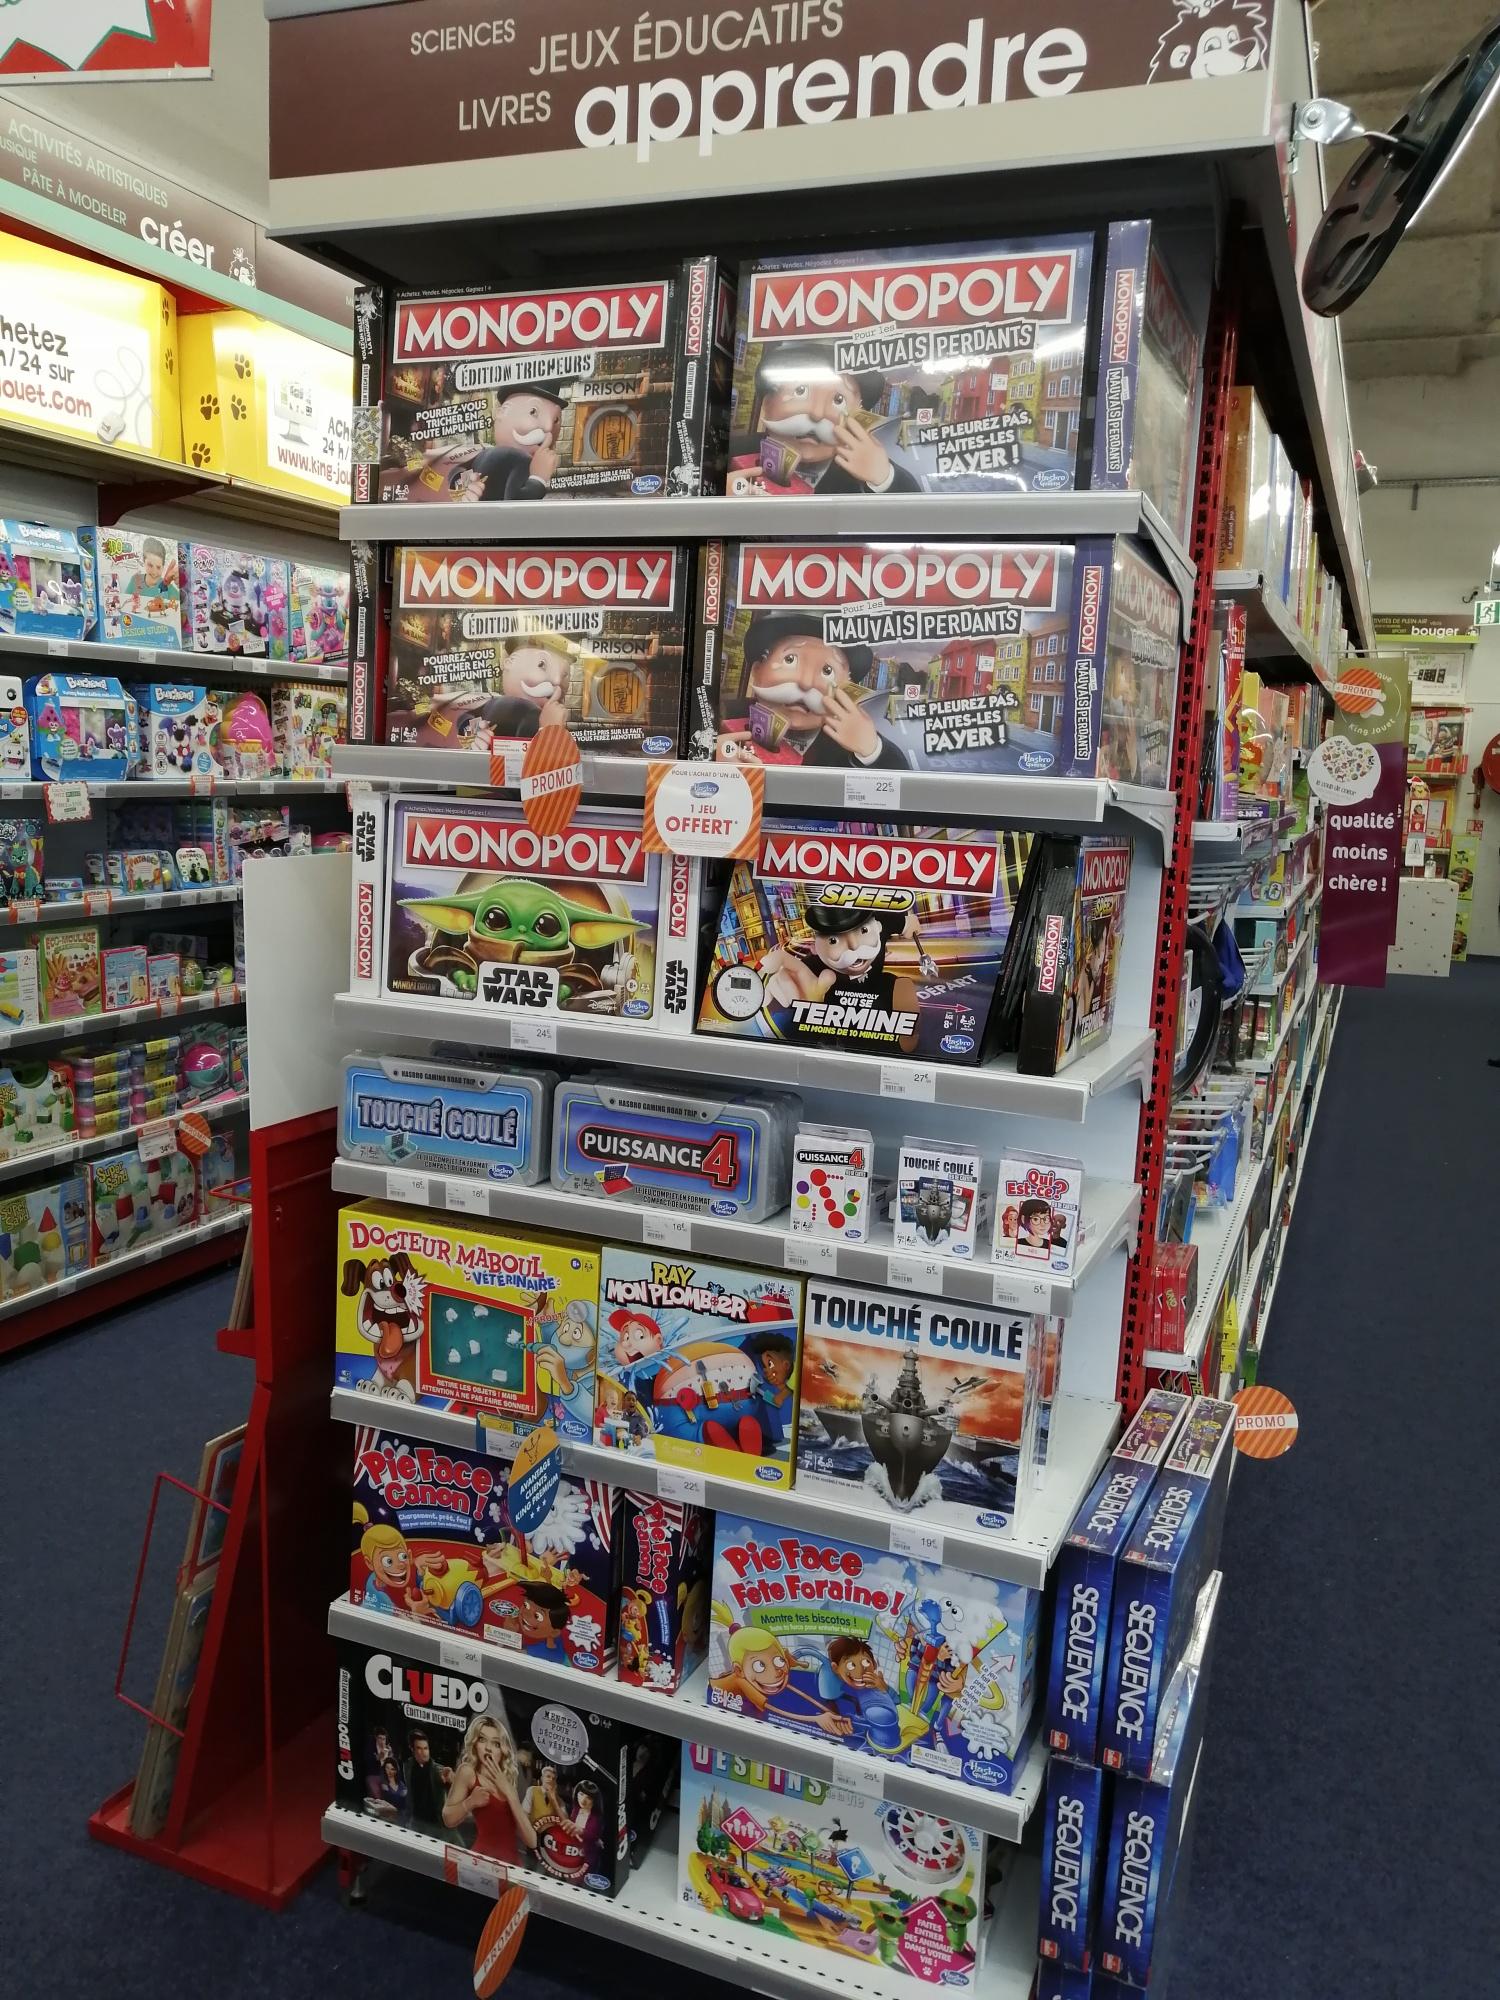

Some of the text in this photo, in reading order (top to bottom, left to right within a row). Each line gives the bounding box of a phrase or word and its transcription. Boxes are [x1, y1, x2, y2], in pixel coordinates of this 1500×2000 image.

[410, 19, 516, 55] SCIENCES
[529, 0, 844, 75] JEUX ÉDUCATIFS
[574, 18, 1088, 163] apprendre
[459, 91, 551, 131] LIVRES
[0, 136, 37, 163] USIQUE
[8, 118, 168, 208] ACTIVITÉS ARTISTIQUES
[23, 167, 126, 226] PÂTE À MODELER
[140, 216, 215, 269] créer
[760, 263, 1063, 330] MONOPOLY
[404, 292, 659, 352] MONOPOLY
[688, 267, 706, 354] MONOPOLY
[1112, 273, 1130, 363] MONOPOLY
[0, 314, 68, 357] hetez
[854, 323, 895, 341] Pour les
[840, 324, 1032, 370] MAUVAIS PERDANTS
[49, 363, 75, 383] sur
[461, 354, 591, 388] ÉDITION TRICHEURS
[0, 379, 92, 418] ouet.com
[584, 381, 636, 396] PRISON
[416, 400, 487, 421] POURREZ-VOUS
[426, 411, 477, 429] TRICHER EN
[411, 416, 484, 441] TOUTE IMPUNITÉ
[920, 411, 1032, 442] NE PLEUREZ PAS,
[937, 429, 1015, 455] FAITES-LES
[277, 446, 351, 485] www.king-jou
[938, 448, 1007, 474] PAYER
[410, 556, 667, 599] MONOPOLY
[705, 542, 720, 622] MONOPOLY
[749, 553, 1050, 600] MONOPOLY
[842, 599, 884, 614] Pour les
[1079, 568, 1099, 654] MONOPOLY
[469, 612, 599, 635] ÉDITION TRICHEURS
[828, 610, 1018, 643] MAUVAIS PERDANTS
[1411, 625, 1460, 639] bouger
[424, 650, 494, 665] POURREZ-VOUS
[592, 641, 646, 654] PRISON
[418, 665, 493, 685] TOUTE IMPUNITÉ
[434, 659, 485, 674] TRICHER EN
[354, 664, 366, 738] MONOPOLY
[1342, 684, 1373, 696] PROMO
[908, 692, 1019, 718] NE PLEUREZ PAS,
[926, 712, 1001, 732] FAITES-LES
[925, 727, 993, 752] PAYER
[532, 768, 573, 794] PROMO
[699, 804, 717, 814] JEU
[1330, 811, 1395, 834] qualité
[356, 811, 376, 862] STAR WARS
[412, 822, 642, 874] MONOPOLY
[762, 838, 991, 886] MONOPOLY
[1332, 843, 1388, 861] moins
[1084, 856, 1128, 891] MONOPOLY
[1329, 873, 1377, 892] chère
[671, 854, 689, 937] ONOPOLY
[821, 884, 914, 911] SPEED
[359, 885, 372, 976] MONOPOLY
[1041, 919, 1060, 991] MONOPOLY
[483, 967, 553, 989] STAR
[664, 959, 688, 1014] STAR WARS
[916, 975, 978, 1000] DÉPART
[483, 984, 553, 1008] WARS
[840, 997, 873, 1008] QUI SE
[844, 992, 879, 1000] MONOPOLY
[792, 1001, 917, 1035] TERMINE
[812, 1026, 835, 1035] MOINS
[859, 1031, 893, 1041] MINUTES
[401, 1070, 476, 1086] HASBRO GAMING ROAD TRIP
[618, 1100, 697, 1117] HASBRO GAMING ROAD TRIP
[359, 1097, 518, 1147] TOUCHÉ COULÉ
[584, 1133, 734, 1185] PUISSANCE 4
[799, 1147, 863, 1170] PUISSANCE 4
[904, 1155, 974, 1175] TOUCHÉ COULÉ
[1028, 1168, 1054, 1187] Qui
[349, 1222, 545, 1280] DOCTEUR MABOUL
[472, 1269, 556, 1292] VÉTÉRINAIRE
[653, 1263, 695, 1286] RAY
[607, 1279, 649, 1303] MON
[811, 1293, 1022, 1360] TOUCHÉ COULÉ
[422, 1384, 454, 1398] ATTENTION
[1237, 1416, 1286, 1428] PROMO
[361, 1447, 492, 1494] Pie Face
[520, 1458, 550, 1495] AVANTAGE
[515, 1473, 559, 1523] KING PREMIUM
[525, 1473, 547, 1500] CLIENTS
[1086, 1473, 1138, 1534] SEQUENCE
[1144, 1488, 1193, 1552] SEQUENCE
[722, 1538, 862, 1578] Pie Face
[730, 1573, 892, 1613] Fête Foraine
[761, 1613, 850, 1626] Montre tes biscotos
[1062, 1583, 1099, 1723] SEQUENCE
[365, 1654, 489, 1713] CLUEDO
[1116, 1599, 1156, 1742] SEQUENCE
[406, 1705, 466, 1729] ÉDITION MENTEURS
[544, 1710, 577, 1729] MENTEZ
[551, 1724, 569, 1735] POUR
[537, 1736, 546, 1746] LA
[539, 1728, 580, 1747] DÉCOUVRIR
[1051, 1795, 1084, 1933] SEQUENCE
[1116, 1810, 1154, 1947] SEQUENCE
[904, 1932, 918, 1943] DES
[914, 1927, 944, 1942] ENTRER
[917, 1918, 942, 1932] FAITES
[904, 1942, 951, 1963] DANS VOTRE
[920, 1954, 932, 1966] VIE
